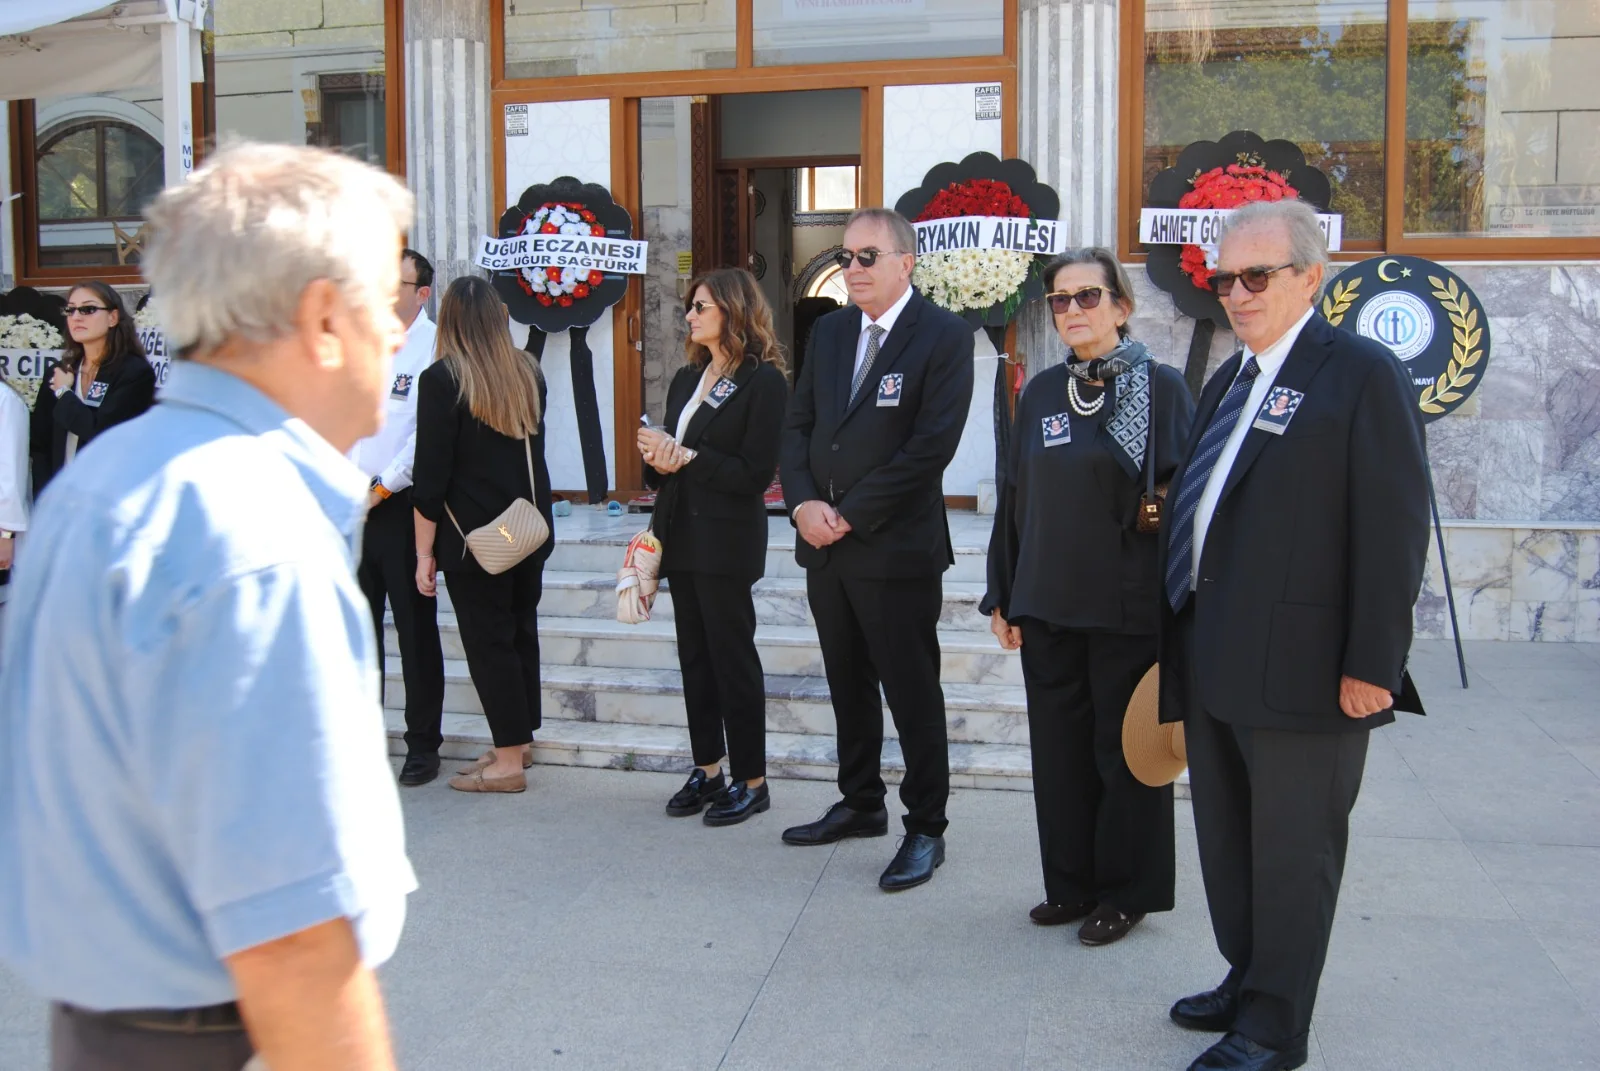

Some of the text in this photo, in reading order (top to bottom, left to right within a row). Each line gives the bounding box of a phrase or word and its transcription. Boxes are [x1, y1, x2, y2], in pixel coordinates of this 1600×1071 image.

[975, 86, 1000, 94] ZAFER
[917, 218, 1056, 253] RYAKIN AİLESİ
[1150, 214, 1197, 243] AHMET
[484, 239, 642, 259] UĞUR ECZANESİ
[481, 254, 639, 271] ECZ. UĞUR SAĞTÜRK
